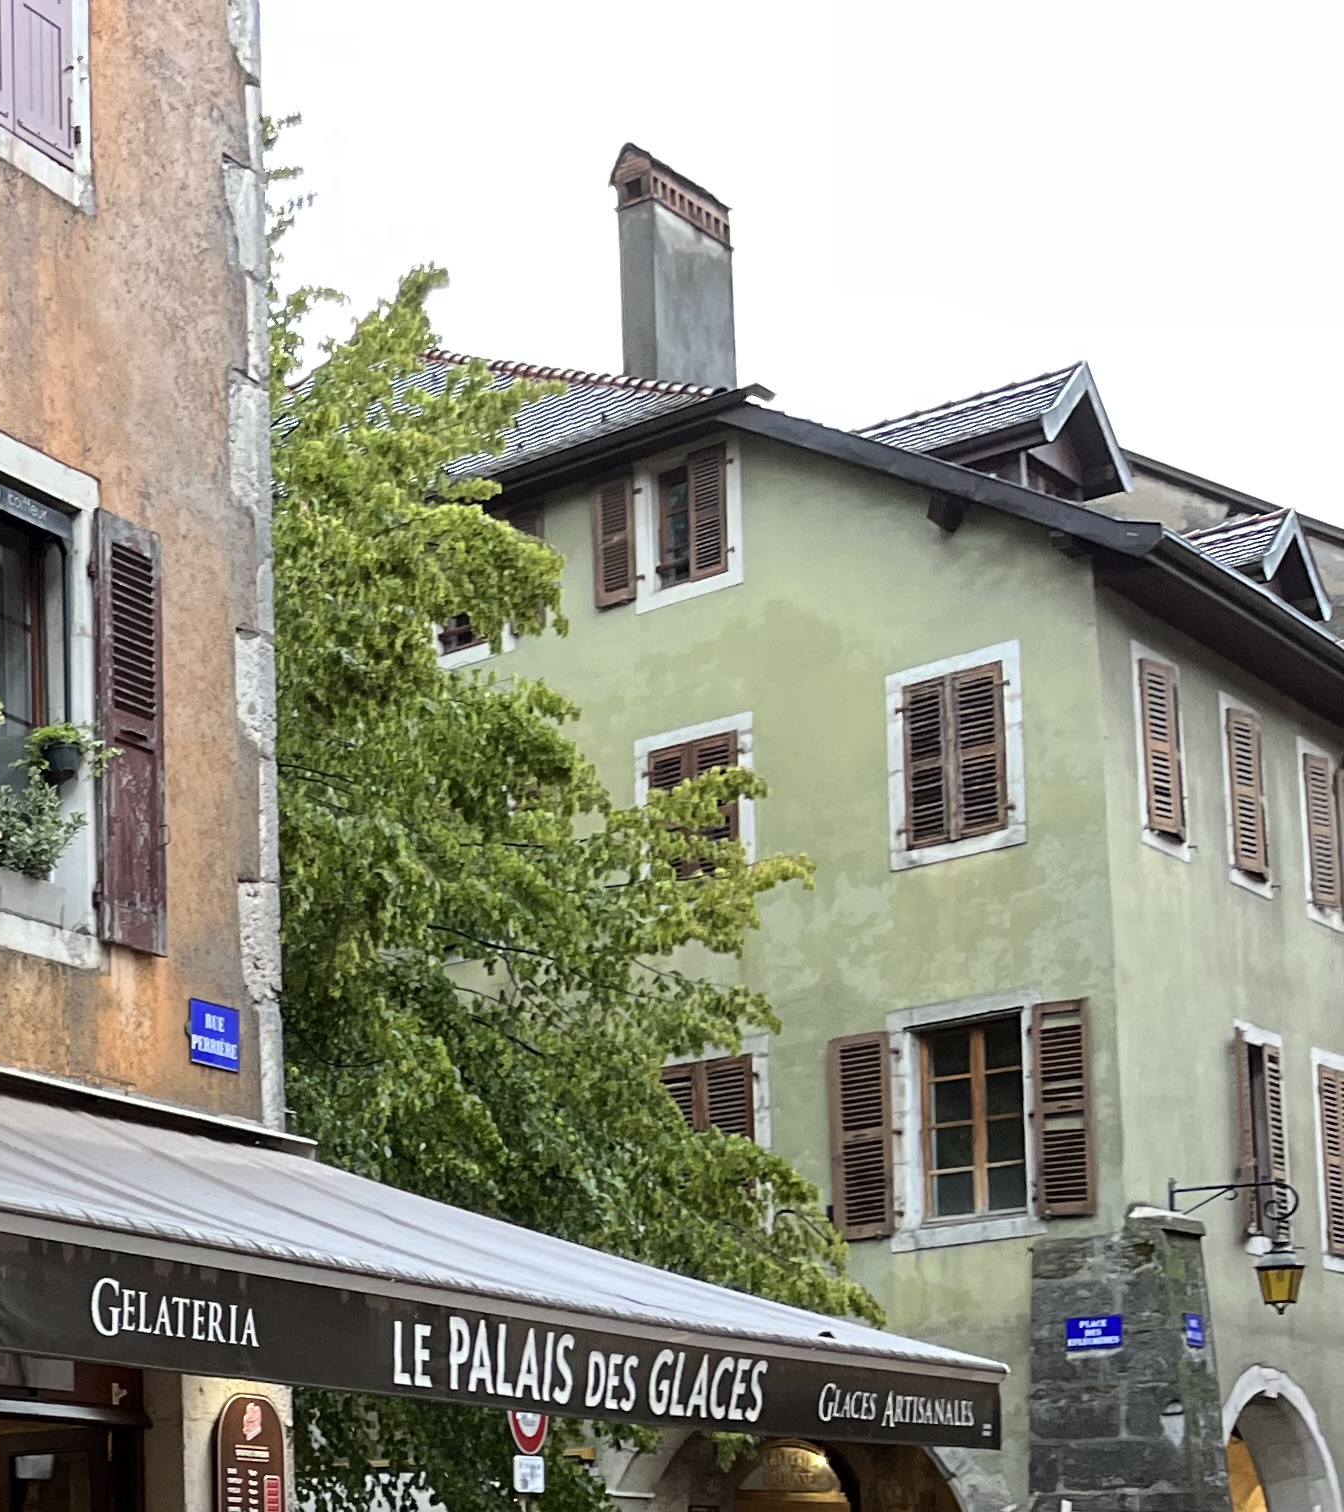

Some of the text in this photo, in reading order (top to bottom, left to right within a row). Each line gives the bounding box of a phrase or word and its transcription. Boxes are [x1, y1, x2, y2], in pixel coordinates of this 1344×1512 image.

[205, 1013, 225, 1033] RUE
[393, 1316, 770, 1424] LE PALAIS DES GLACES
